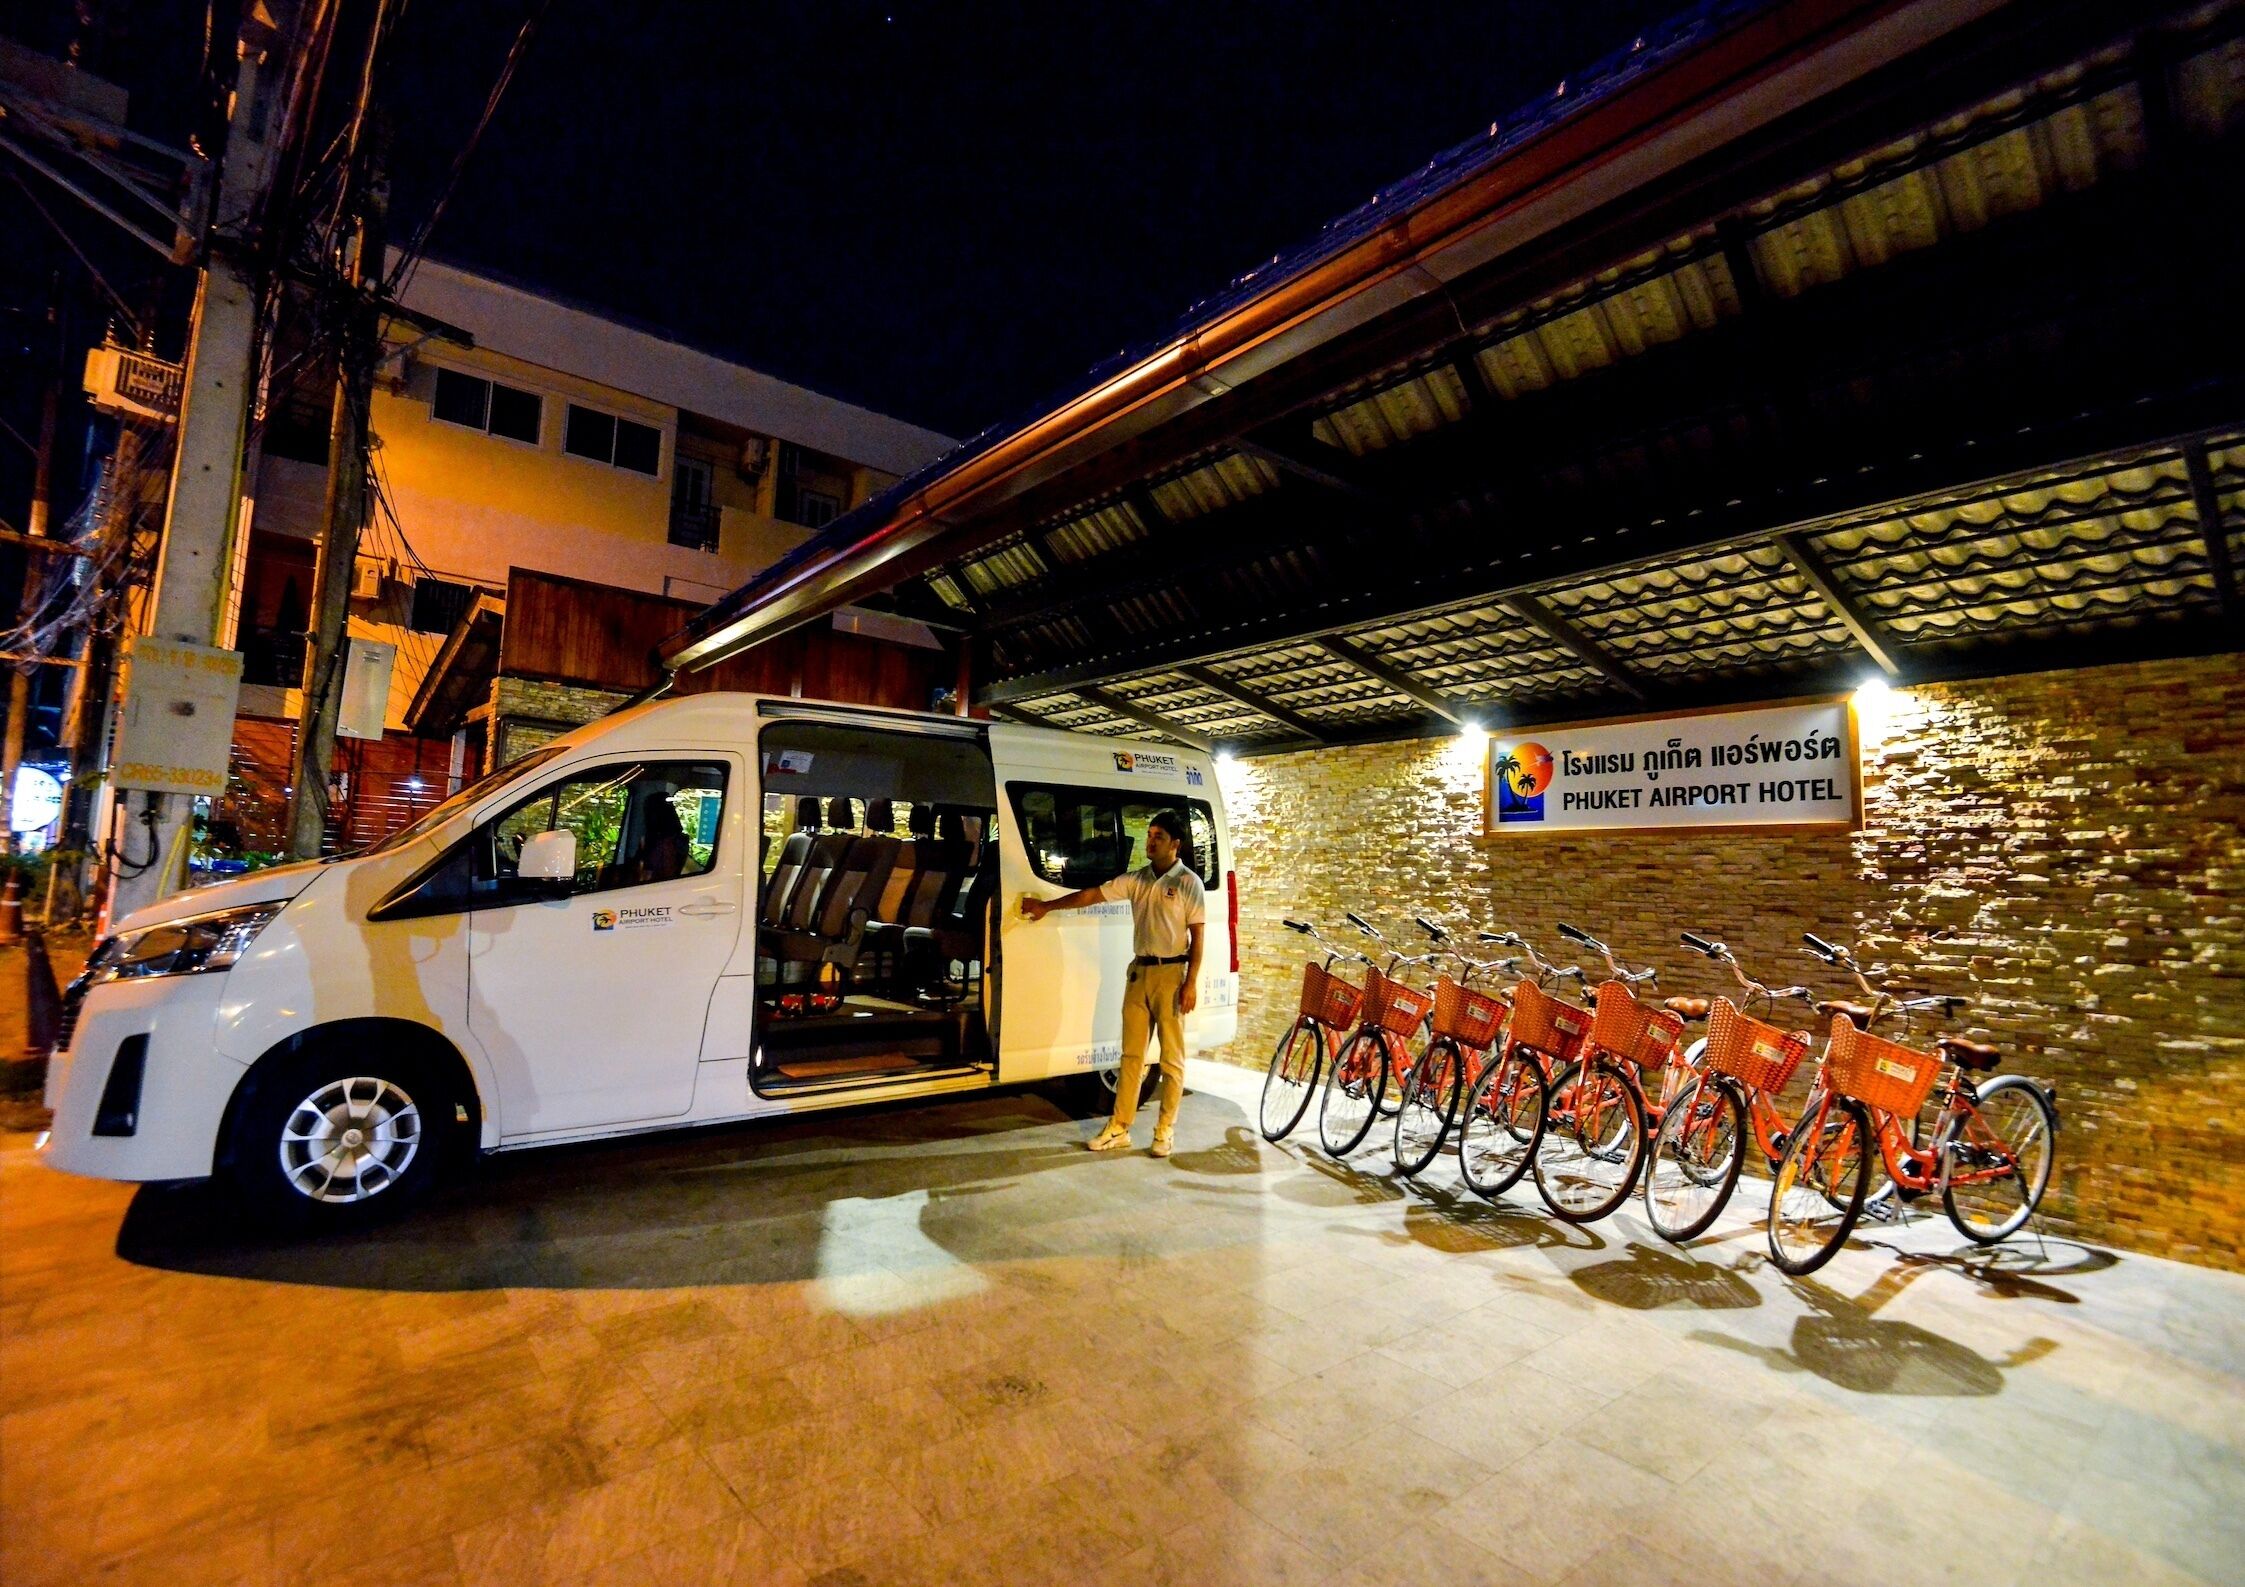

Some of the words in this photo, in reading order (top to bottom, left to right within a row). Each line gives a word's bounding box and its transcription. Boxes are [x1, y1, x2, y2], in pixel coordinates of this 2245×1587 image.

[1135, 754, 1174, 766] PHUKET
[1562, 749, 1634, 777] โรงแรม
[1643, 738, 1701, 781] ภูเก็ต
[1711, 729, 1841, 766] แอร์พอร์ต
[1135, 763, 1159, 771] AIRPORT
[1562, 788, 1642, 810] PHUKET
[1649, 783, 1751, 807] AIRPORT
[1759, 778, 1843, 802] HOTEL
[620, 907, 672, 918] PHUKET
